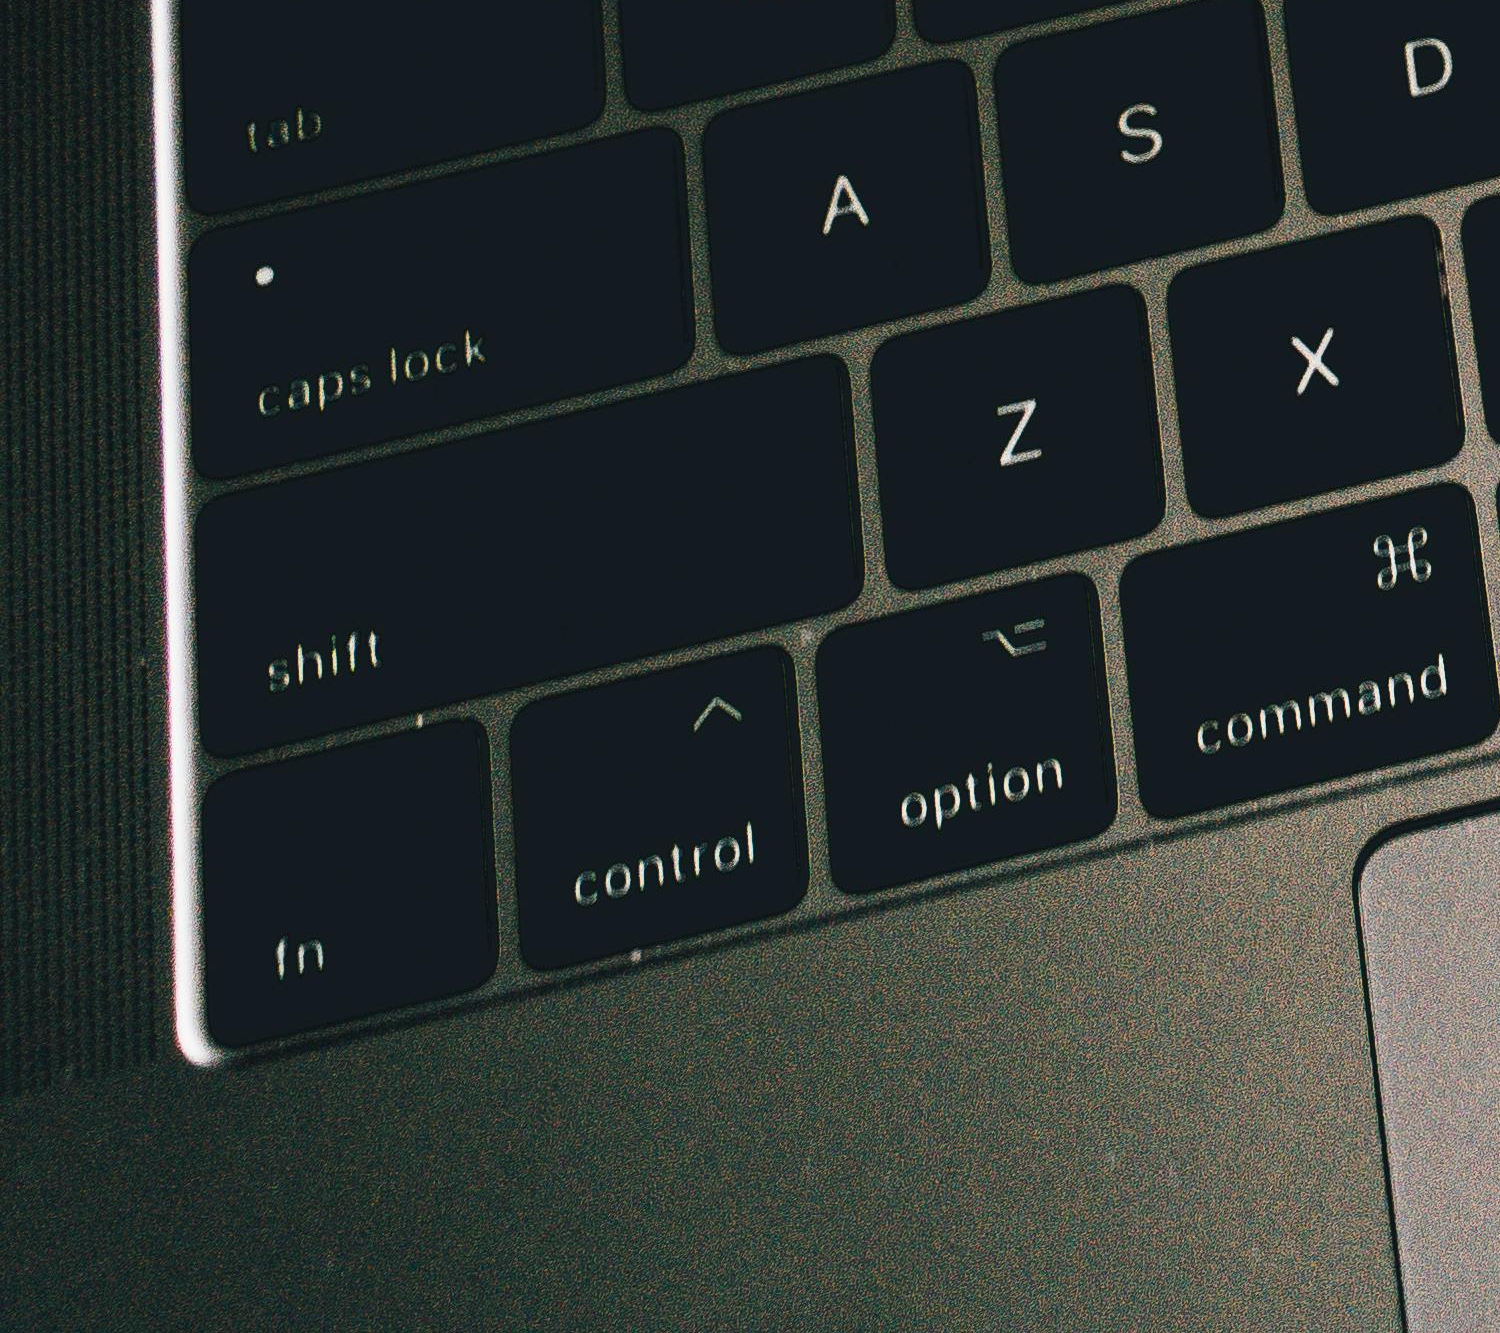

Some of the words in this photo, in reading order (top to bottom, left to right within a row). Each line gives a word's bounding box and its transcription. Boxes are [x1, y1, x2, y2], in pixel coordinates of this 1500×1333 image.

[1404, 38, 1453, 97] D
[248, 110, 322, 151] tab
[1118, 104, 1163, 163] S
[823, 175, 869, 234] A
[256, 359, 372, 419] caps
[390, 330, 489, 385] lock
[1291, 328, 1339, 395] X
[997, 399, 1042, 466] Z
[264, 627, 384, 695] shift
[1194, 653, 1452, 757] command
[898, 753, 1065, 833] option
[571, 822, 758, 908] control
[272, 934, 328, 981] fn
